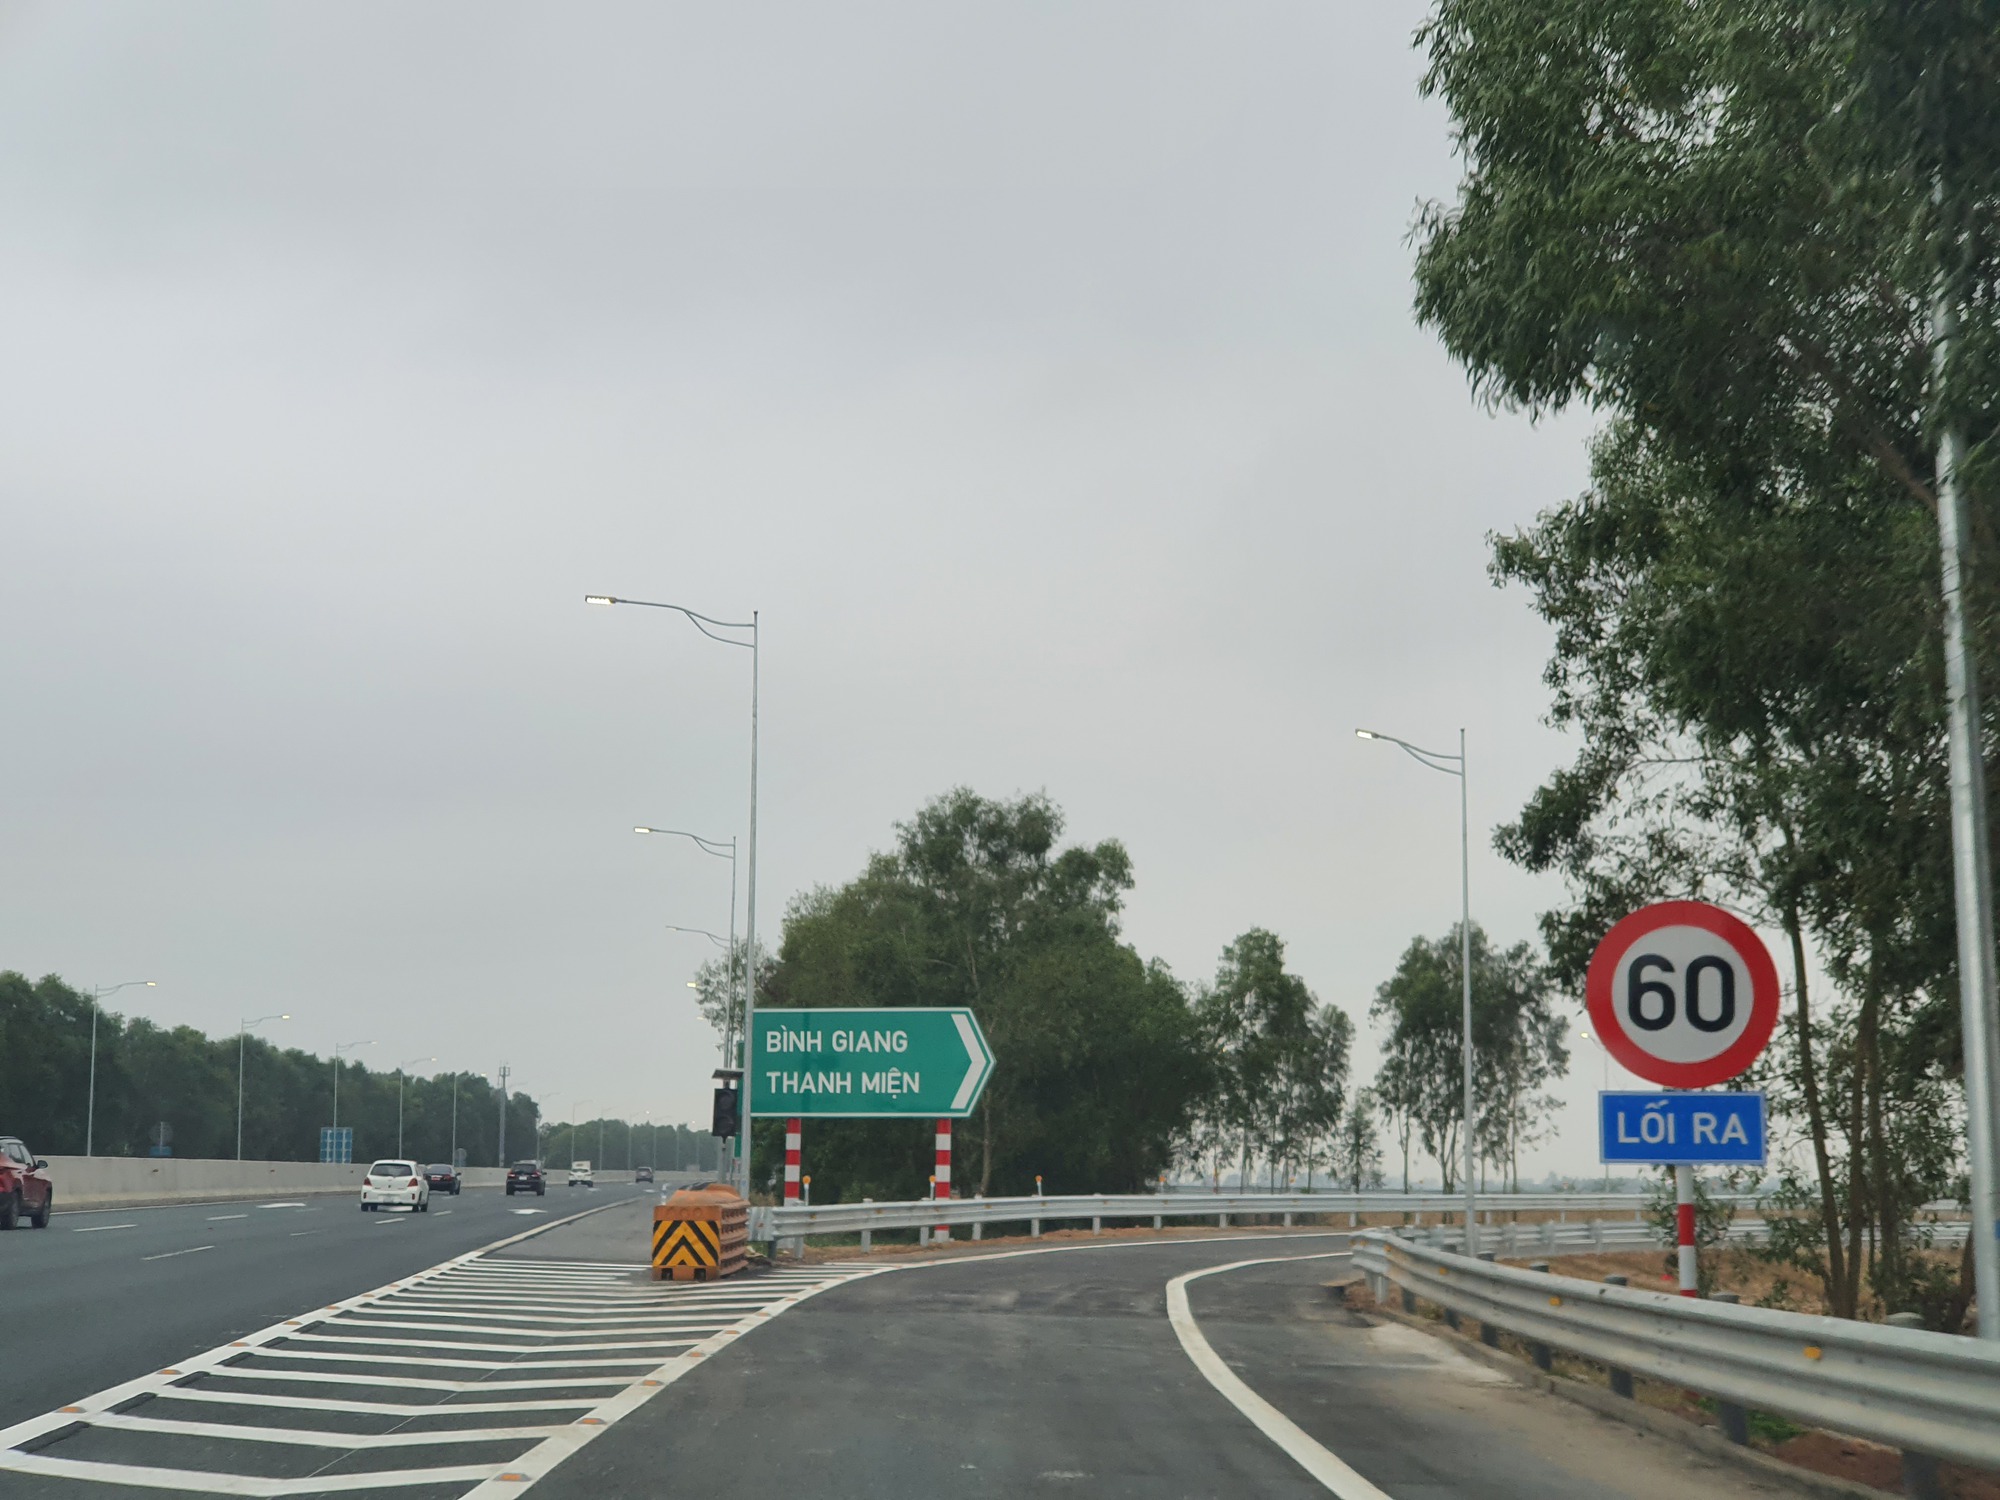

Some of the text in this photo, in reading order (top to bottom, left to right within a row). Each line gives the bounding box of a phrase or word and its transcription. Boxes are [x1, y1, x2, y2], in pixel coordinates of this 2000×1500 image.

[1628, 953, 1735, 1032] 60
[766, 1025, 908, 1053] BÌNH GIANG
[766, 1067, 920, 1099] THANH MIỆN
[1617, 1099, 1749, 1145] LỐI RA
